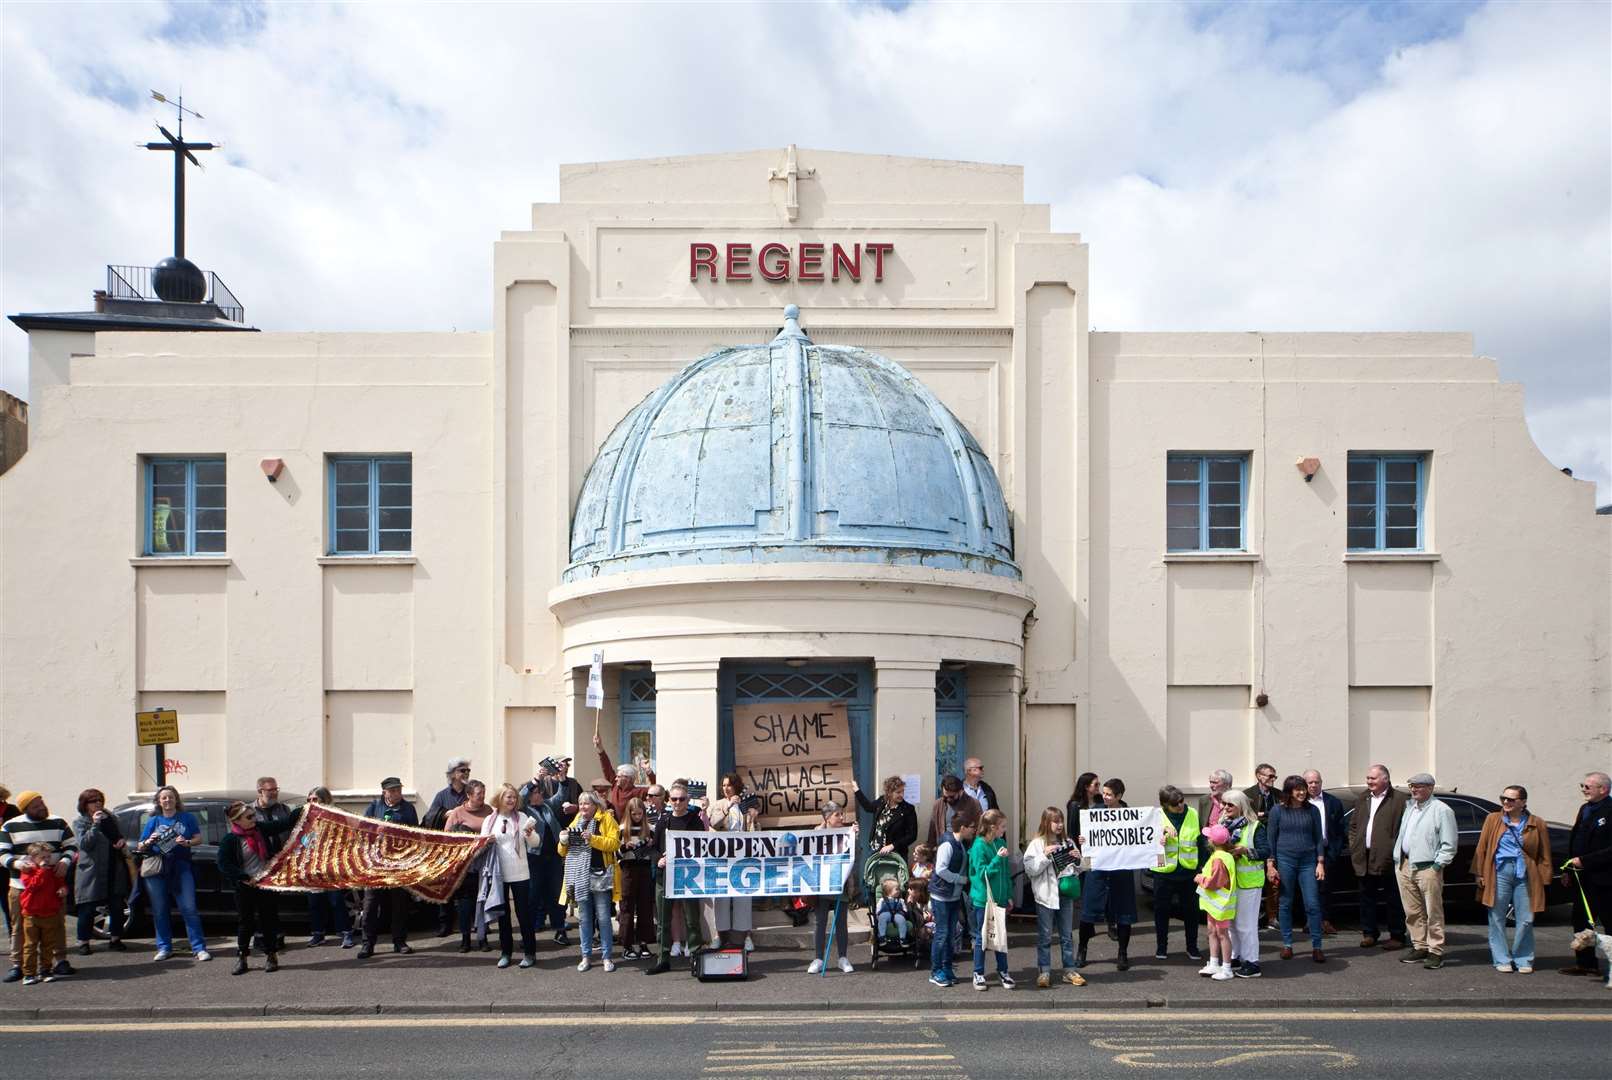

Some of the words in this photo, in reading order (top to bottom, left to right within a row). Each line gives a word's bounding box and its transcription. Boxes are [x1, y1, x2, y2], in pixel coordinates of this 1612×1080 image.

[690, 242, 894, 282] REGENT
[753, 712, 836, 742] SHAME
[782, 743, 810, 756] ON
[748, 763, 840, 791] WALLACE
[1089, 809, 1143, 822] MISSION:
[674, 837, 778, 858] REOPEN
[798, 833, 850, 856] THE
[1089, 826, 1154, 847] IMPOSSIBLE?
[673, 854, 851, 895] REGENT
[1064, 1023, 1361, 1069] BUS
